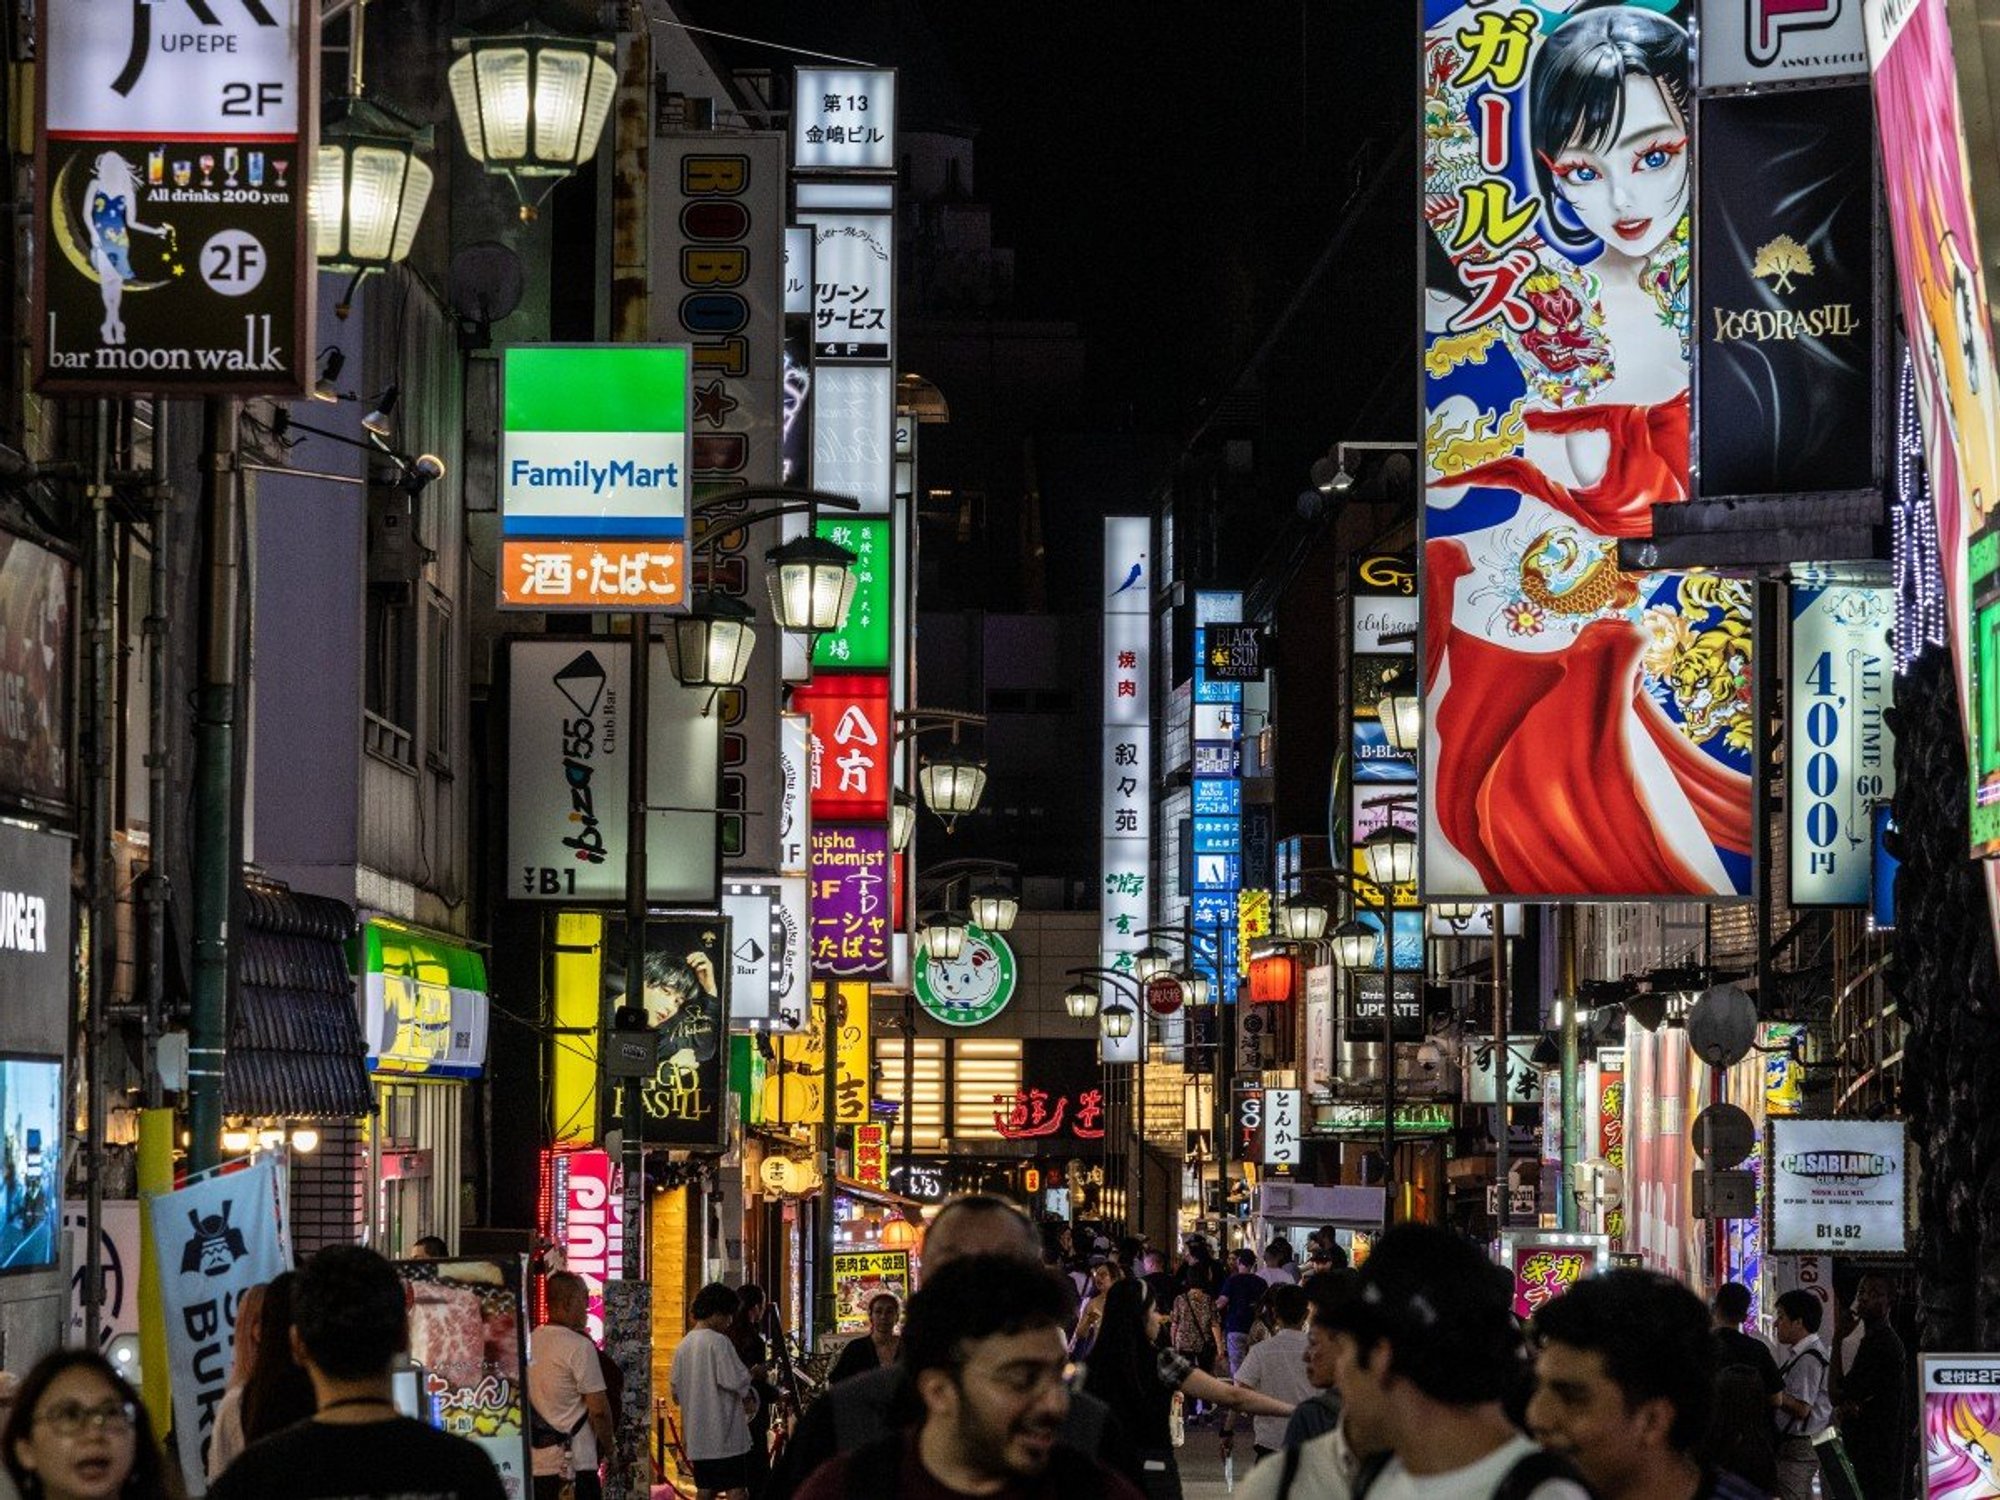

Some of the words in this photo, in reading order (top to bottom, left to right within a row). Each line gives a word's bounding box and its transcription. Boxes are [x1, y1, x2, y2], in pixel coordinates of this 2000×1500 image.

[161, 34, 238, 53] UPEPE
[1780, 55, 1820, 69] ANNEX
[221, 83, 283, 117] 2F
[805, 125, 885, 145] 金嶋ビル
[1450, 10, 1540, 332] ガールズ
[147, 188, 169, 203] All
[171, 188, 219, 203] drinks
[222, 188, 260, 203] 200
[262, 190, 289, 204] yen
[208, 245, 259, 282] 2F
[680, 154, 751, 377] ROBOT
[817, 308, 886, 330] サービス
[1712, 303, 1859, 343] YGGDRASILL
[48, 311, 90, 370] bar
[95, 343, 191, 370] moon
[195, 314, 286, 371] walk
[511, 460, 679, 494] FamilyMart
[520, 552, 677, 596] 酒・たばこ
[1216, 628, 1258, 647] BLACK
[1231, 646, 1258, 667] SUN
[1117, 651, 1137, 698] 焼肉
[1861, 653, 1882, 703] ALL
[602, 688, 617, 717] Bar
[602, 719, 617, 755] Club
[1861, 707, 1882, 769] TIME
[1805, 650, 1846, 875] 4,000円
[1115, 743, 1138, 832] 叙々苑
[540, 868, 576, 895] B1
[811, 912, 885, 934] ーシャ
[811, 935, 884, 958] たばこ
[736, 965, 758, 975] Bar
[1394, 991, 1415, 1000] Cafe
[1274, 1091, 1293, 1161] とんかつ
[1784, 1153, 1895, 1174] CASABLANCA
[1817, 1224, 1832, 1238] B1
[1835, 1228, 1843, 1238] &
[1844, 1225, 1861, 1239] B2
[835, 1257, 905, 1273] 焼肉食べ放題
